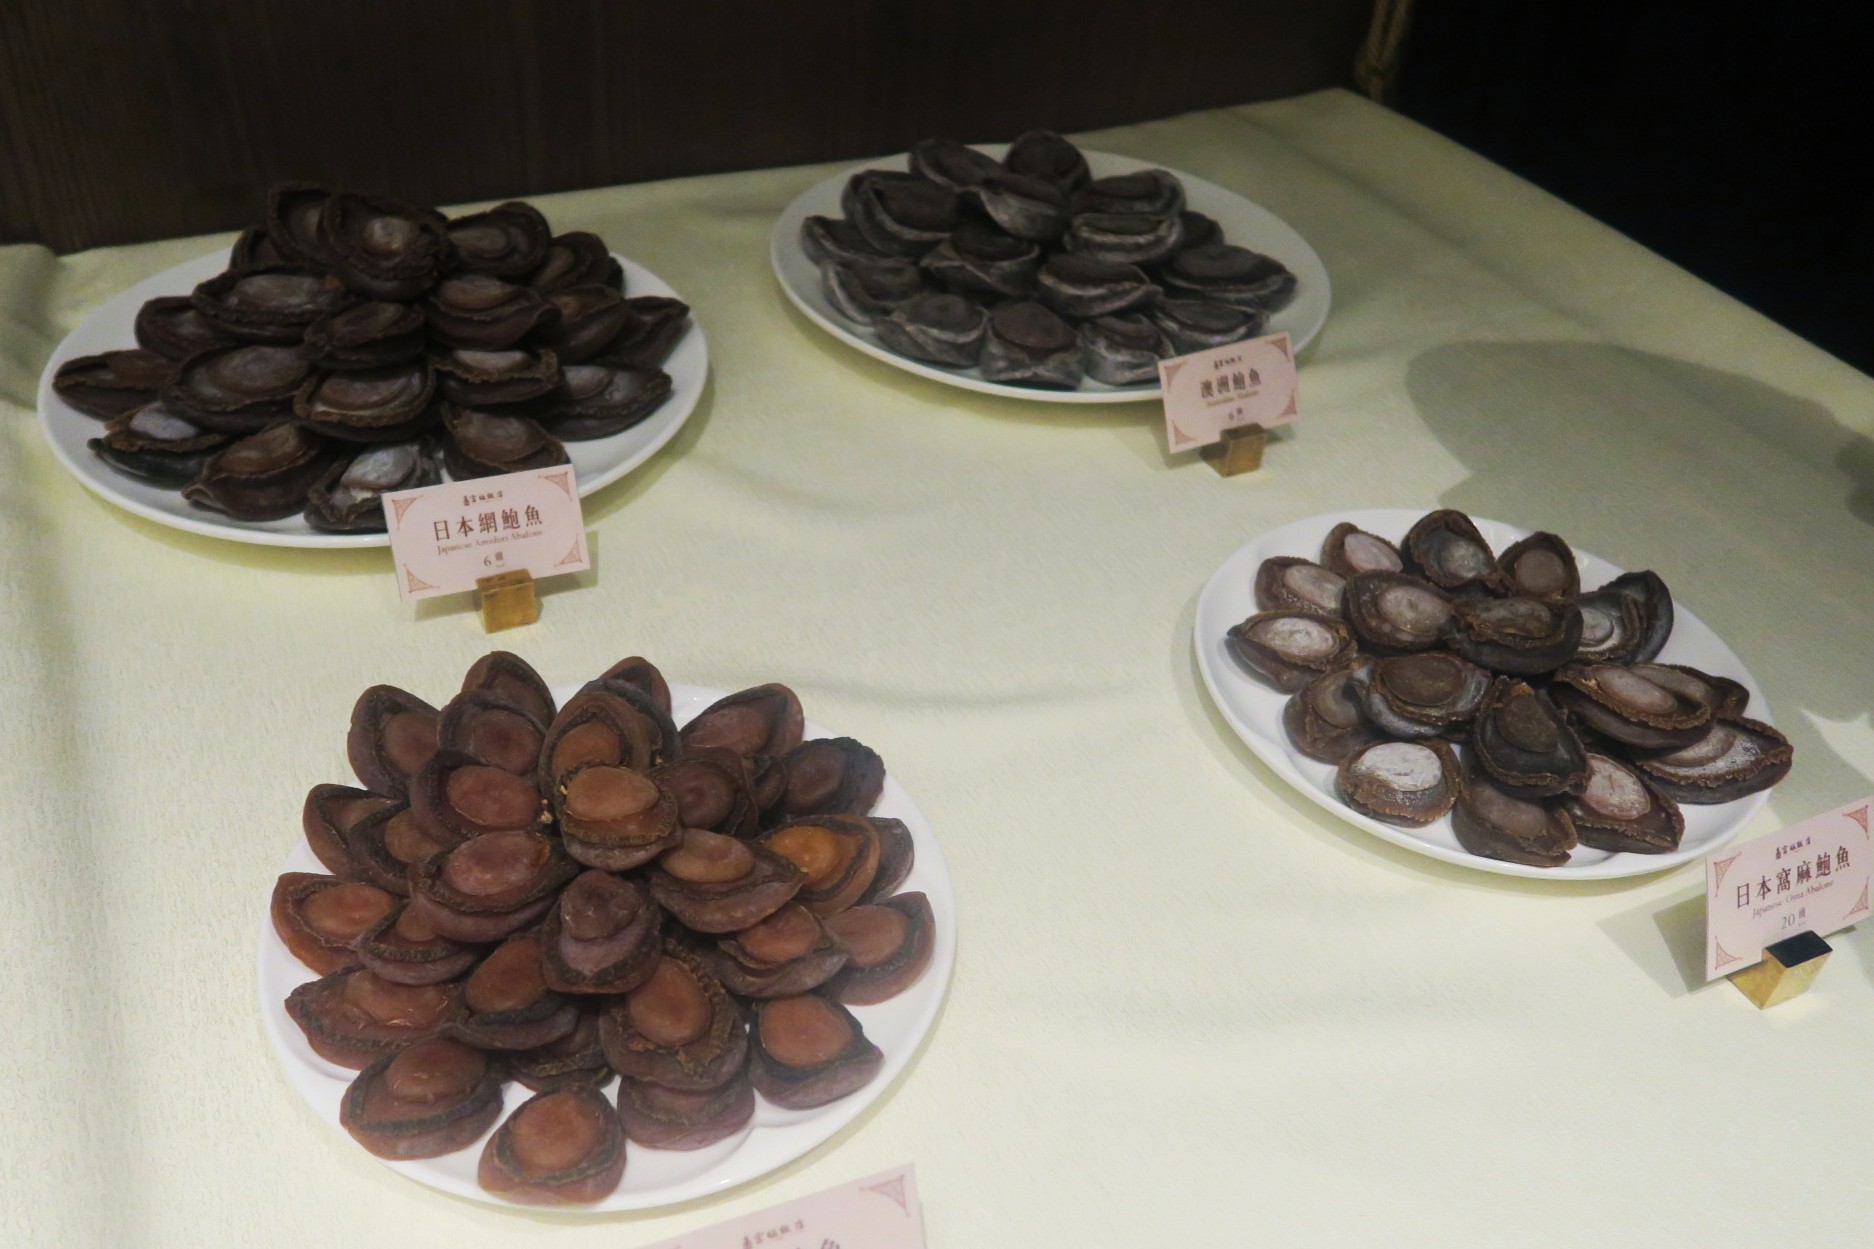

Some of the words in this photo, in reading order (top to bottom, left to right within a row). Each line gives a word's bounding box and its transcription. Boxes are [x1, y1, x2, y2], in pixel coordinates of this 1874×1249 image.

[433, 504, 543, 542] 日本網鮑魚
[437, 541, 473, 556] Japanese
[483, 555, 492, 567] 6
[1736, 845, 1850, 909] 日本窩麻鮑魚
[1781, 913, 1796, 930] 20
